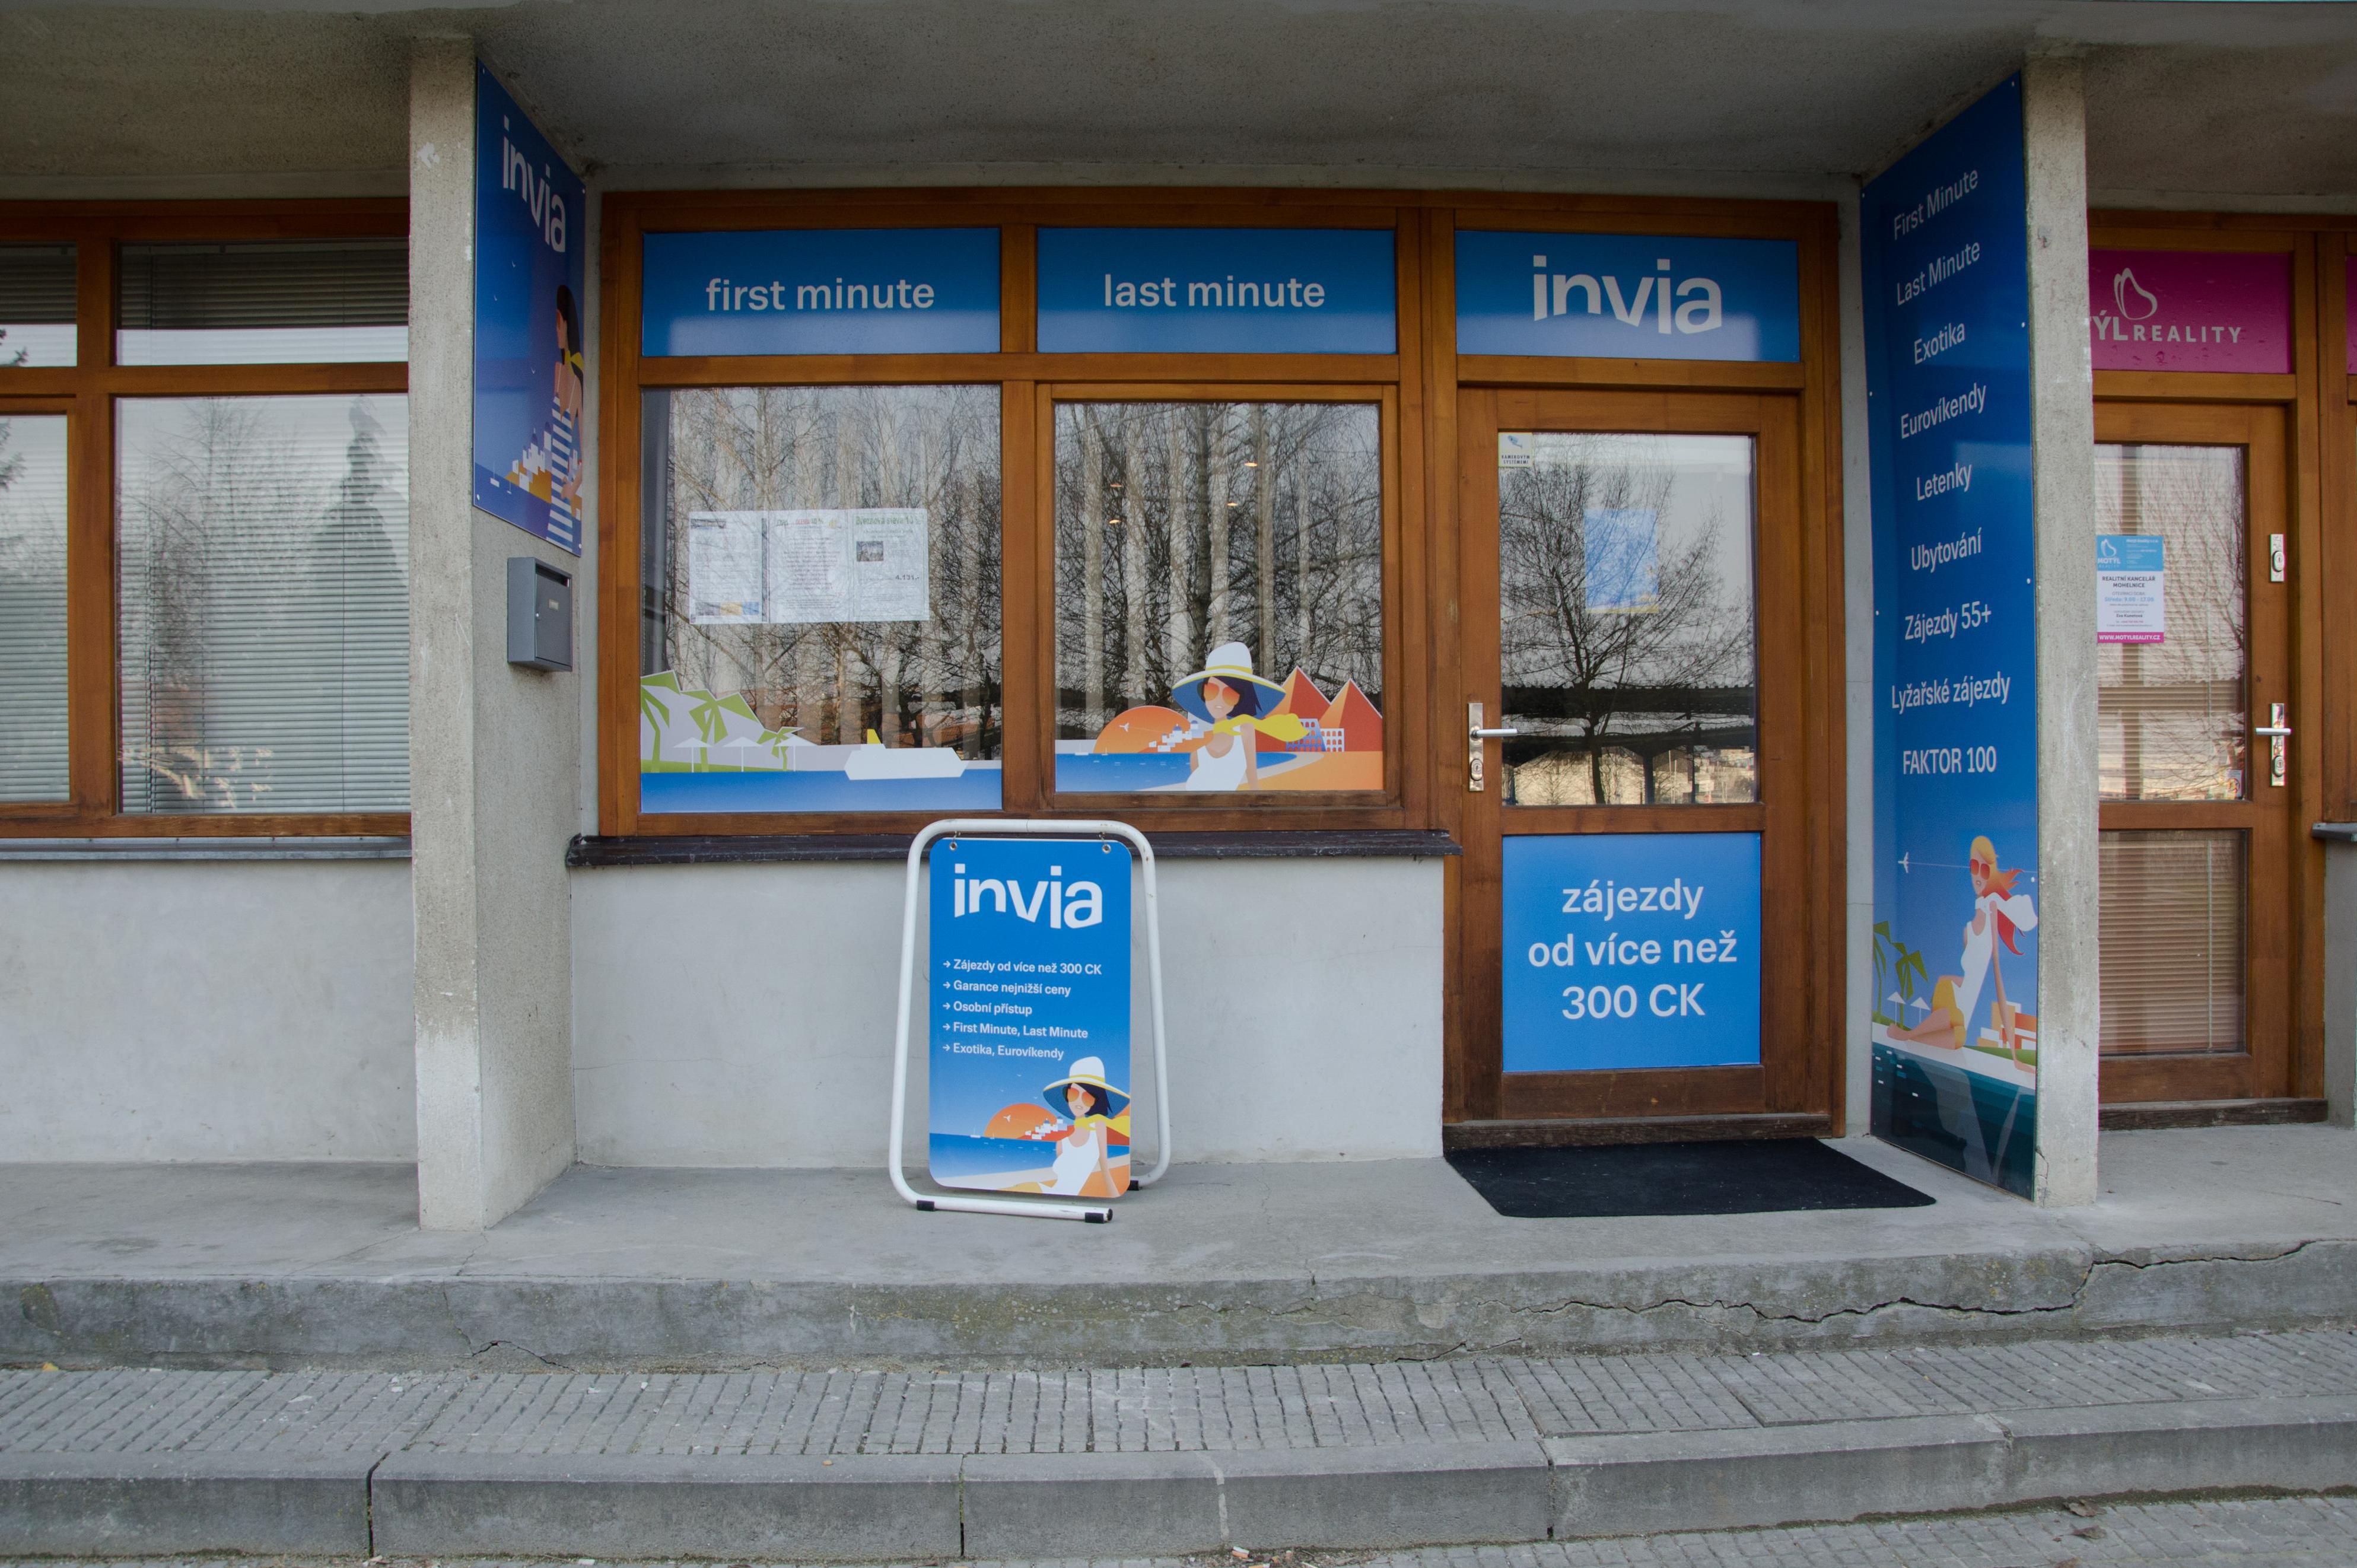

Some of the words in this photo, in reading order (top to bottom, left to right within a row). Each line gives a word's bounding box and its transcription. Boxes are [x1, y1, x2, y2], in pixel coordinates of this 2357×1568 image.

[502, 115, 565, 253] invia
[1894, 202, 1924, 241] First
[1926, 169, 1979, 216] Minute
[1105, 273, 1177, 307] last
[1188, 275, 1325, 307] minute
[1897, 271, 1926, 306] Last
[1928, 241, 1980, 288] Minute
[706, 278, 785, 310] first
[797, 277, 935, 310] minute
[1533, 255, 1722, 335] invia
[1914, 323, 1965, 365] Exotika
[2133, 325, 2241, 343] REALITY
[1901, 383, 1986, 439] Eurovíkendy
[1917, 462, 1973, 501] Letenky
[1911, 527, 1982, 573] Ubytování
[1905, 608, 1958, 644] Zájezdy
[1961, 600, 1992, 629] 55+
[1892, 678, 1949, 714] Lyžařské
[1953, 671, 2011, 708] zájezdy
[1903, 748, 1962, 774] FAKTOR
[1967, 746, 1997, 773] 100
[955, 864, 1103, 929] invia
[1562, 878, 1704, 921] zájezdy
[953, 959, 995, 974] Zájezdy
[997, 960, 1011, 972] od
[1013, 961, 1035, 972] více
[1038, 962, 1057, 974] než
[1060, 963, 1082, 974] 300
[1084, 963, 1102, 975] CK
[1528, 933, 1574, 967] od
[1585, 932, 1661, 965] více
[1673, 930, 1737, 963] než
[953, 979, 999, 992] Garance
[1001, 982, 1043, 995] nejnižší
[1045, 986, 1071, 998] ceny
[1562, 985, 1638, 1020] 300
[1649, 983, 1706, 1017] CK
[953, 1001, 992, 1013] Osobní
[994, 1003, 1032, 1017] přístup
[953, 1021, 978, 1033] First
[979, 1023, 1020, 1037] Minute,
[1023, 1025, 1047, 1037] Last
[1049, 1026, 1089, 1039] Minute
[953, 1042, 995, 1057] Exotika,
[997, 1045, 1064, 1061] Eurovíkendy
